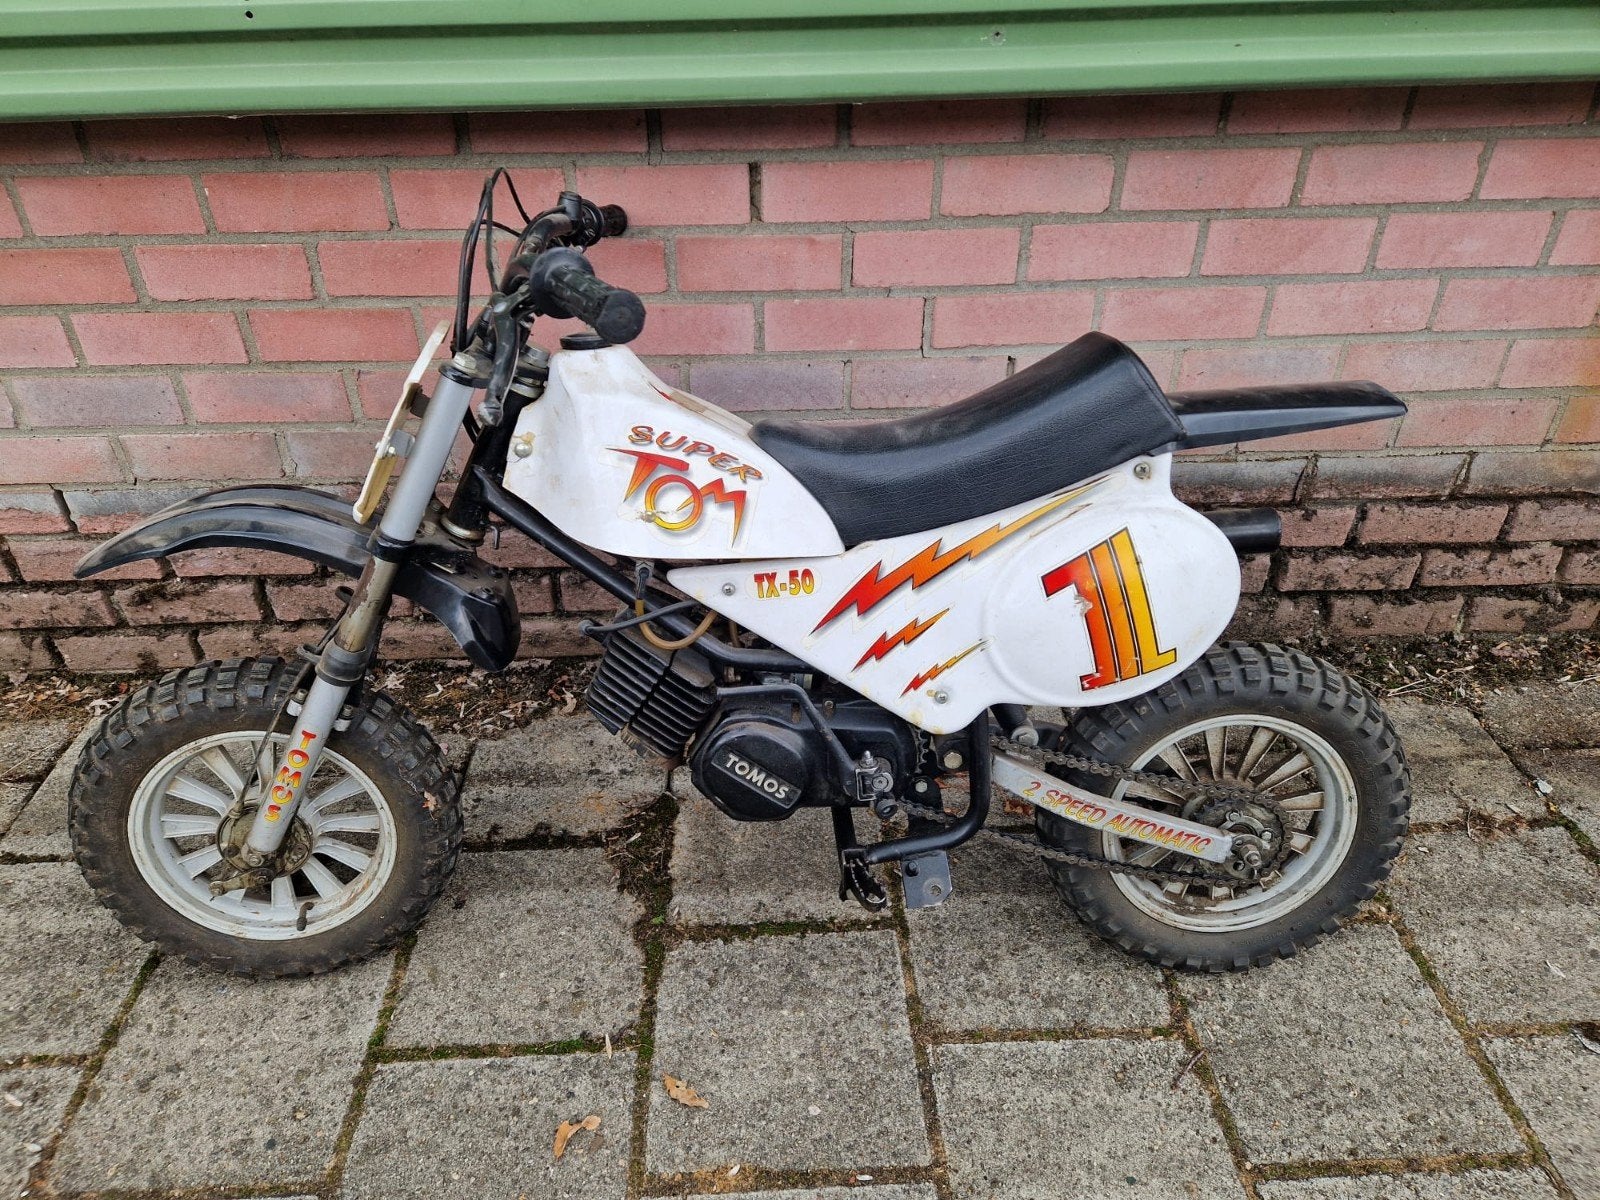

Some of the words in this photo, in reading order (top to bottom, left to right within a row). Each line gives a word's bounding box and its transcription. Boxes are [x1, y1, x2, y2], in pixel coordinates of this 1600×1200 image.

[628, 425, 763, 484] SUPER
[605, 447, 747, 548] TOM
[753, 568, 815, 598] TX-50
[724, 752, 790, 800] TOMOS
[1022, 781, 1042, 798] 2
[1042, 789, 1107, 824] SPEED
[1106, 813, 1212, 854] AUTOMATIC
